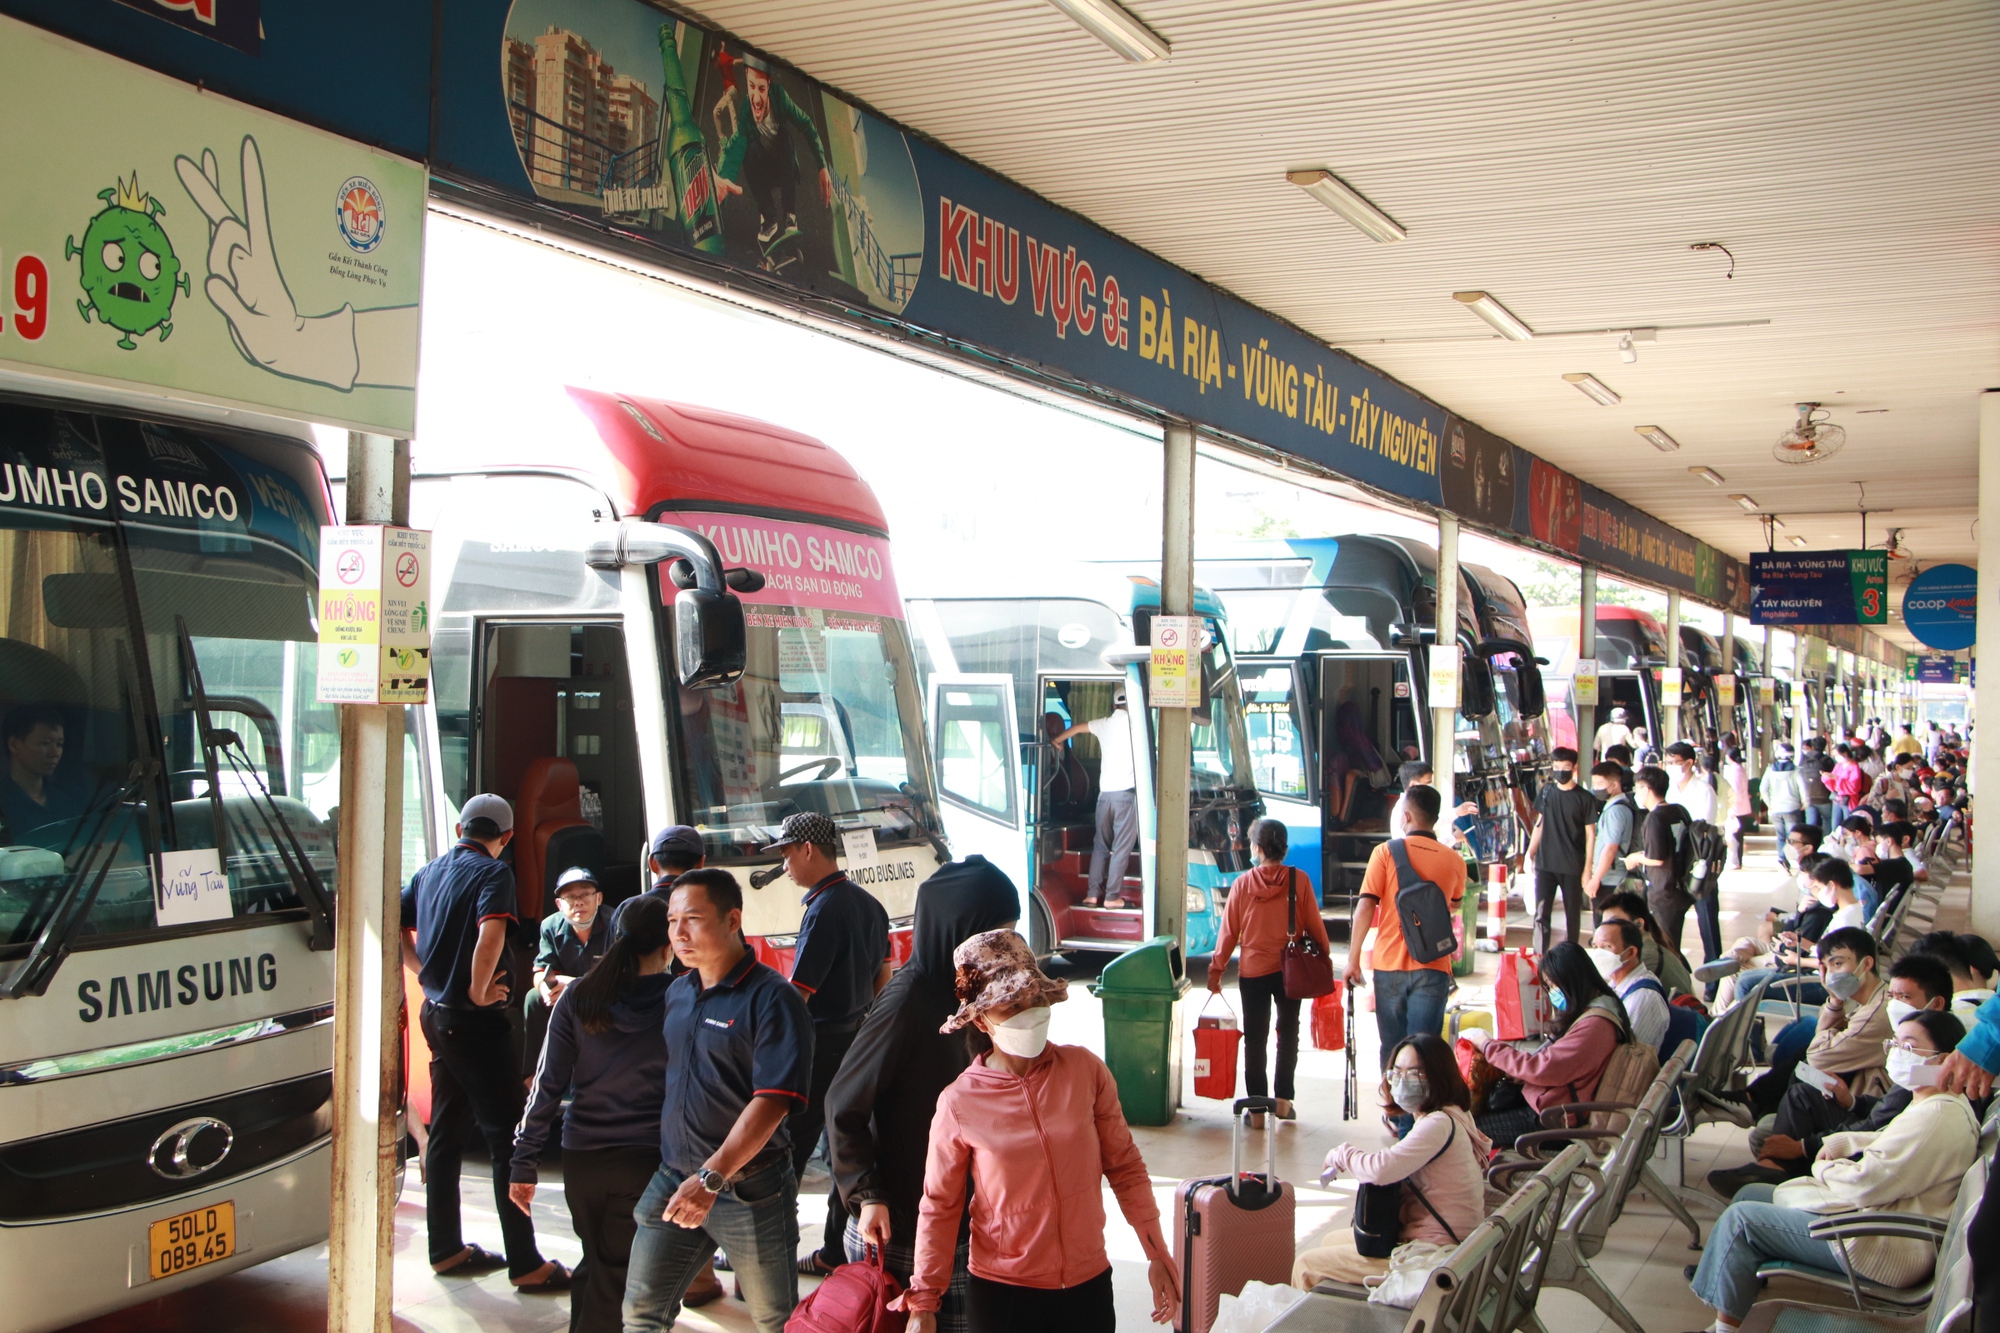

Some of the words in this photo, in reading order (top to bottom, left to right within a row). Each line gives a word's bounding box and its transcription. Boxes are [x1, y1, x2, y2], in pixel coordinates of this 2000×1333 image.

[330, 265, 346, 278] Đồng
[347, 269, 362, 282] Lòng
[362, 274, 377, 286] Phục
[342, 255, 353, 264] Kết
[354, 259, 372, 271] Thành
[373, 264, 389, 276] Công
[4, 255, 48, 340] 9
[939, 195, 1019, 306] KHU
[1026, 234, 1096, 339] VỰC
[1101, 274, 1129, 351] 3:
[1139, 288, 1175, 370] BÀ
[1183, 316, 1222, 395] RỊA
[1241, 339, 1298, 419] VŨNG
[1303, 364, 1339, 436] TÀU
[1351, 388, 1379, 451] TÂY
[1381, 412, 1437, 476] NGUYÊN
[0, 463, 108, 510] UMHO
[117, 475, 238, 521] SAMCO
[698, 524, 802, 569] KUMHO
[806, 536, 883, 581] SAMCO
[1762, 560, 1774, 570] BÀ
[1776, 561, 1791, 571] RỊA
[1798, 560, 1825, 569] VŨNG
[1827, 560, 1845, 568] TÀU
[1789, 571, 1808, 580] Vung
[1810, 571, 1823, 579] Tau
[1852, 558, 1867, 573] KHU
[1868, 556, 1884, 573] VỰC
[765, 569, 792, 590] ÁCH
[794, 576, 819, 596] SẠN
[821, 579, 832, 595] DI
[834, 579, 863, 600] ĐỘNG
[324, 591, 376, 623] KHÔNG
[384, 608, 399, 616] LÒNG
[1761, 598, 1778, 608] TÂY
[1780, 597, 1822, 608] NGUYÊN
[1863, 588, 1880, 617] 3
[1908, 599, 1946, 611] co.op
[1947, 595, 1977, 607] smil
[387, 618, 394, 626] VỆ
[763, 614, 774, 627] XE
[1761, 611, 1798, 619] Highlands
[1154, 650, 1184, 666] KHÔNG
[161, 865, 198, 901] Vũng
[200, 870, 226, 893] Tàu
[844, 866, 875, 885] SAMCO
[876, 861, 915, 882] BUSLINES
[78, 952, 278, 1024] SAMSUNG
[168, 1209, 218, 1244] 50LD
[160, 1232, 227, 1274] 089.45
